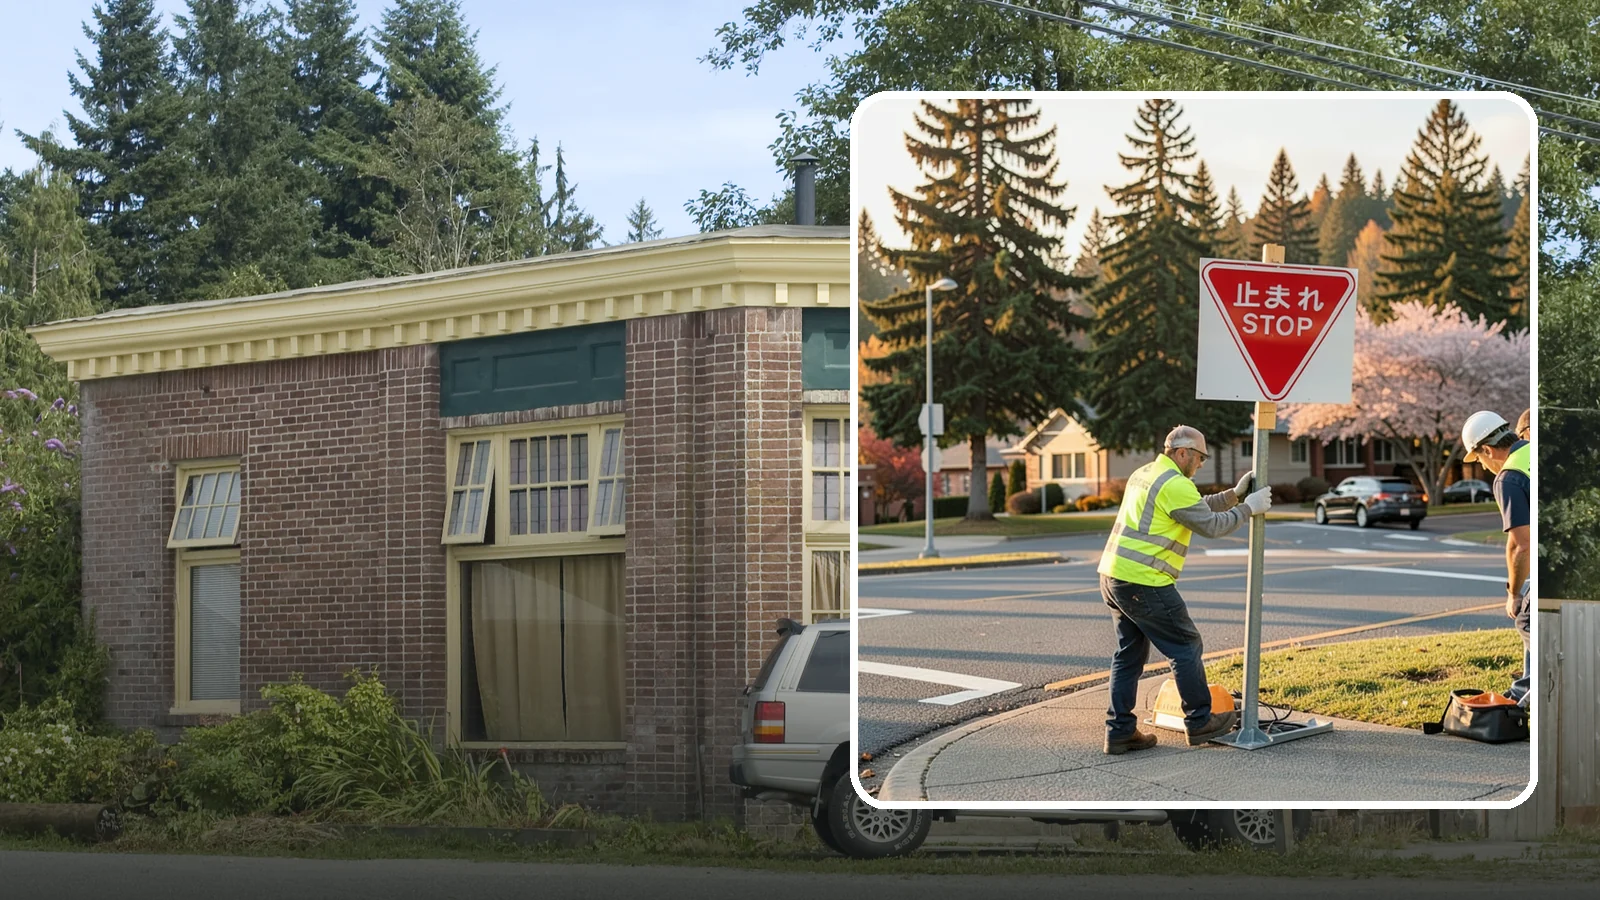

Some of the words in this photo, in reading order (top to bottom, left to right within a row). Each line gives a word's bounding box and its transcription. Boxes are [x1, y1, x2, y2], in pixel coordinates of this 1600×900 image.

[1233, 281, 1324, 312] 止まれ
[1242, 313, 1313, 337] STOP
